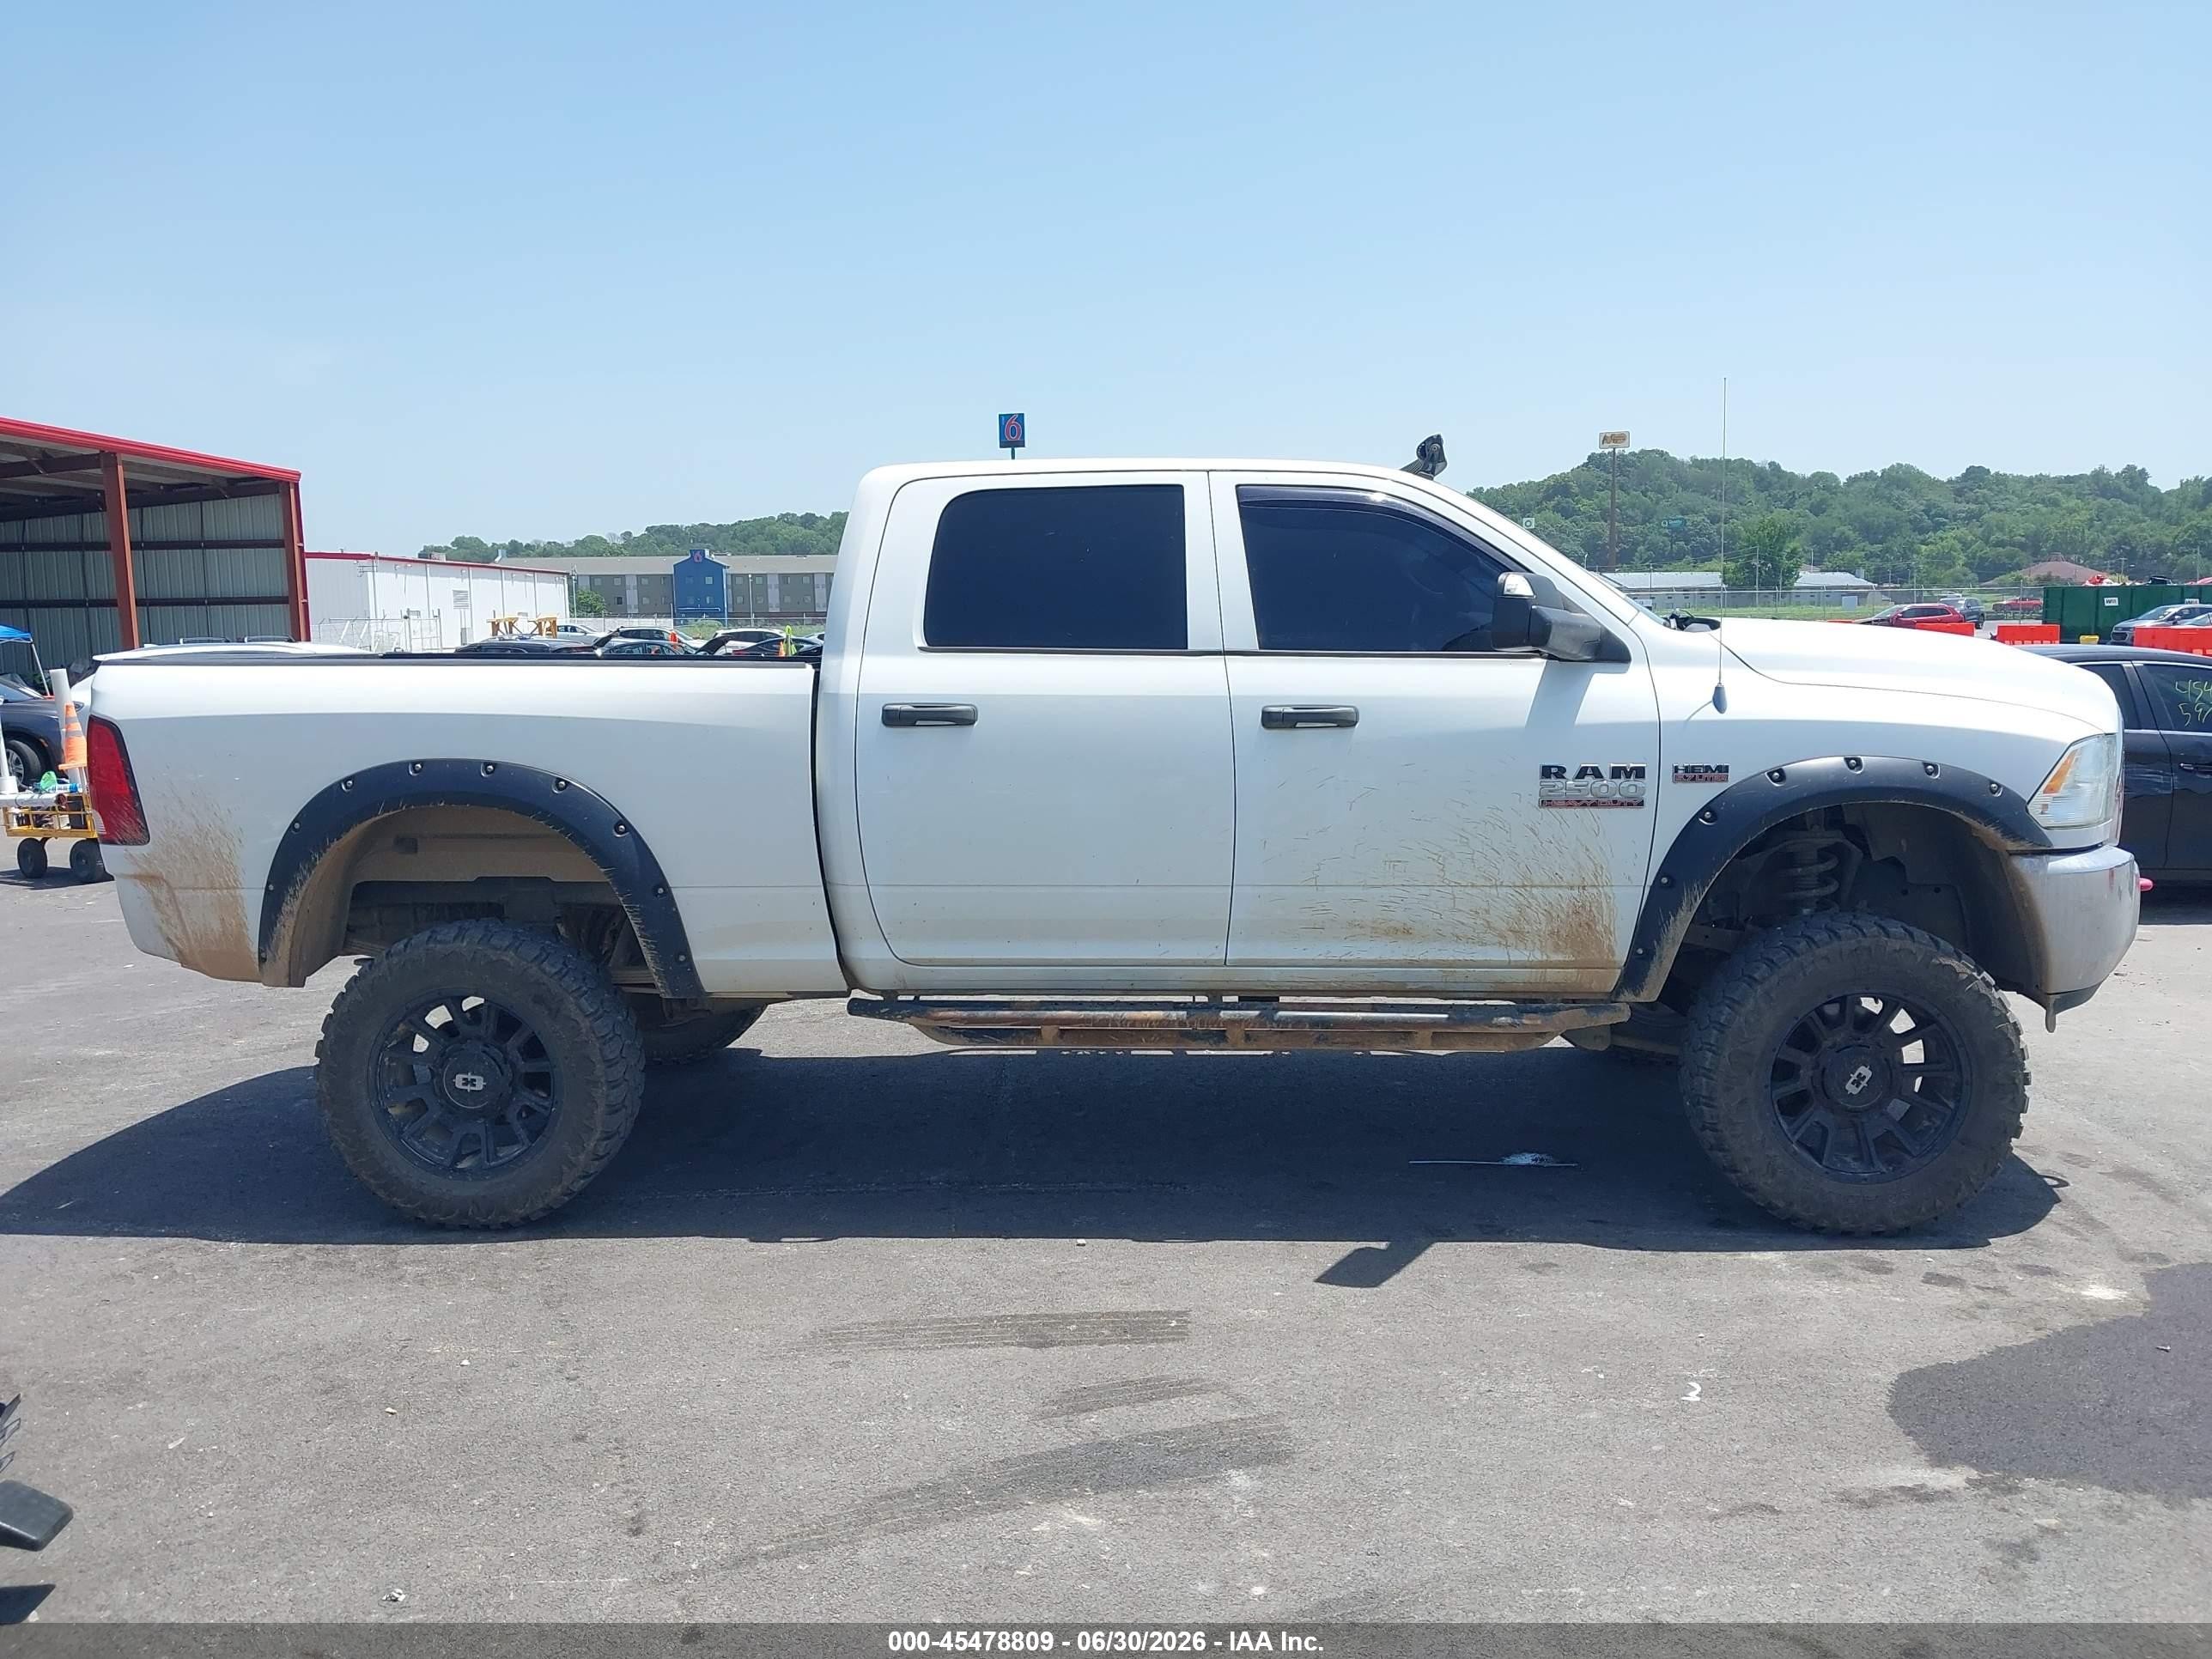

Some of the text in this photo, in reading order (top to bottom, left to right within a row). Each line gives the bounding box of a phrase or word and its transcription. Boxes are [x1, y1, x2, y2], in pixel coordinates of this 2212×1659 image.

[1005, 414, 1022, 441] 6
[1540, 763, 1646, 780] RAM
[1673, 763, 1729, 774] HEMI
[1539, 780, 1646, 798] 2500
[1543, 799, 1642, 807] HEAVY DUTY
